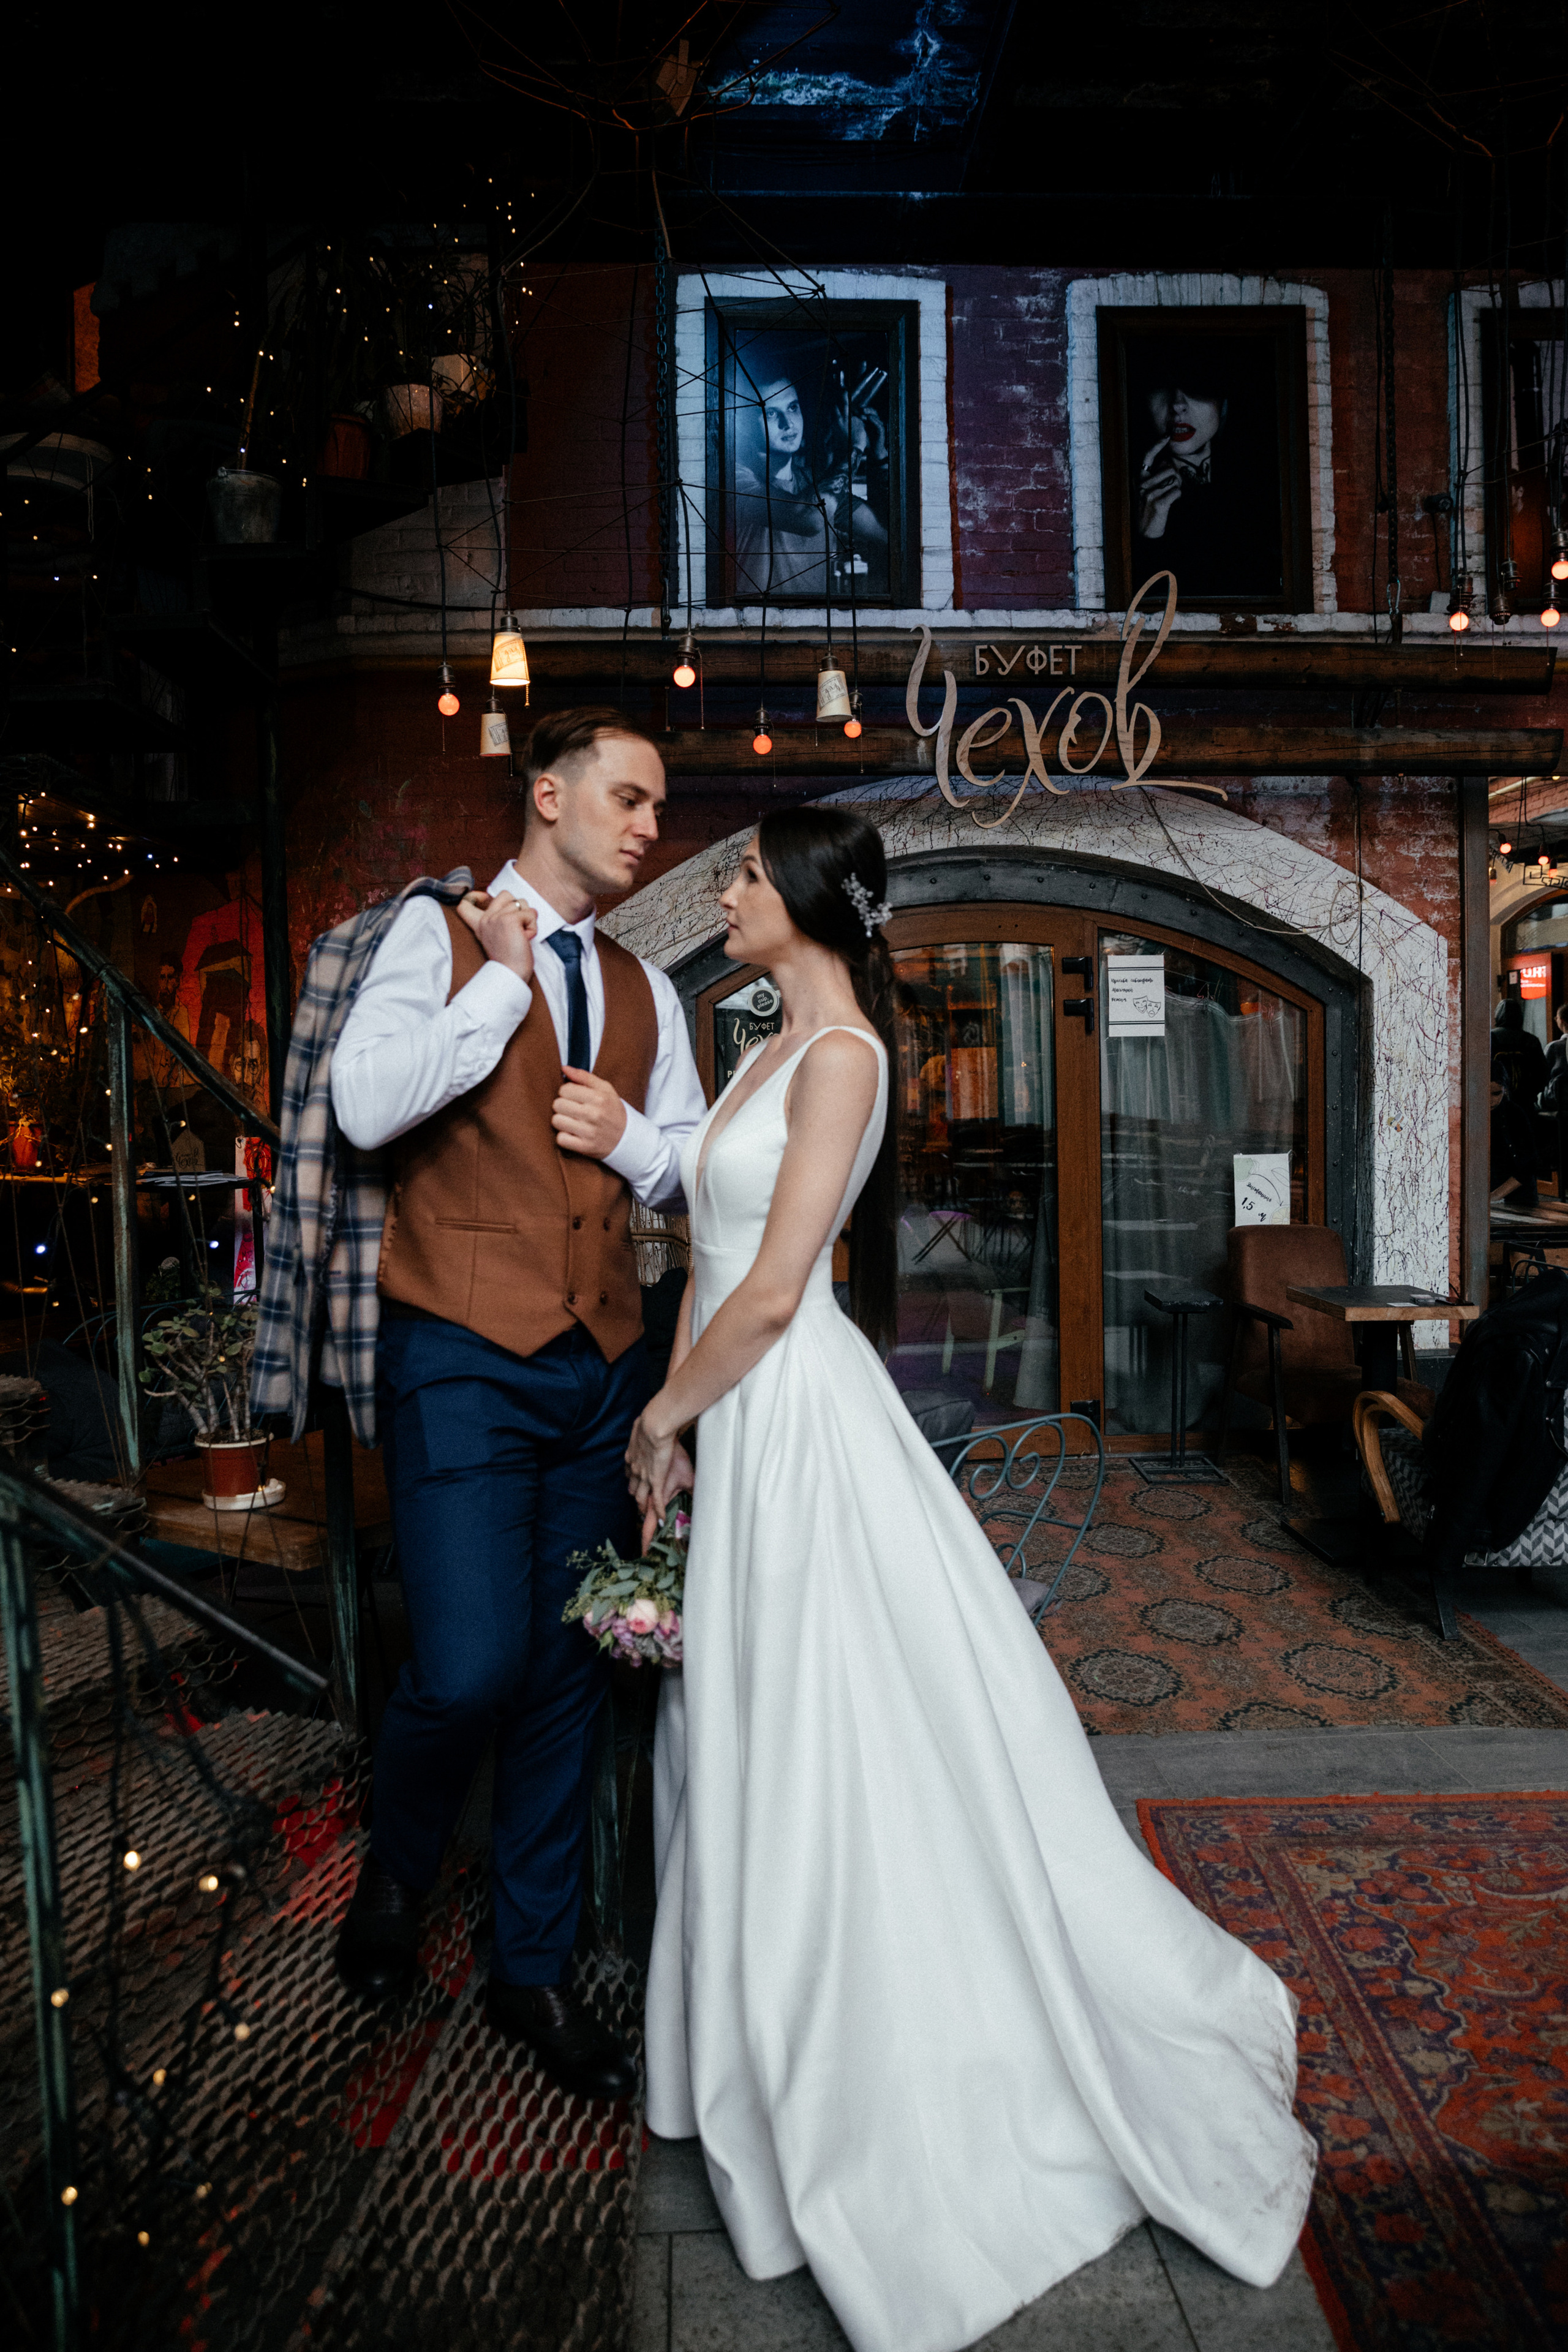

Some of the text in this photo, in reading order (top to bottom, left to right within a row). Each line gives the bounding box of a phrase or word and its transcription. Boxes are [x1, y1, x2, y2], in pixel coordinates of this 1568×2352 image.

[974, 644, 1082, 676] БУФЕТ
[906, 570, 1228, 829] Чехов
[757, 999, 773, 1009] please
[1242, 1197, 1256, 1210] 1,5
